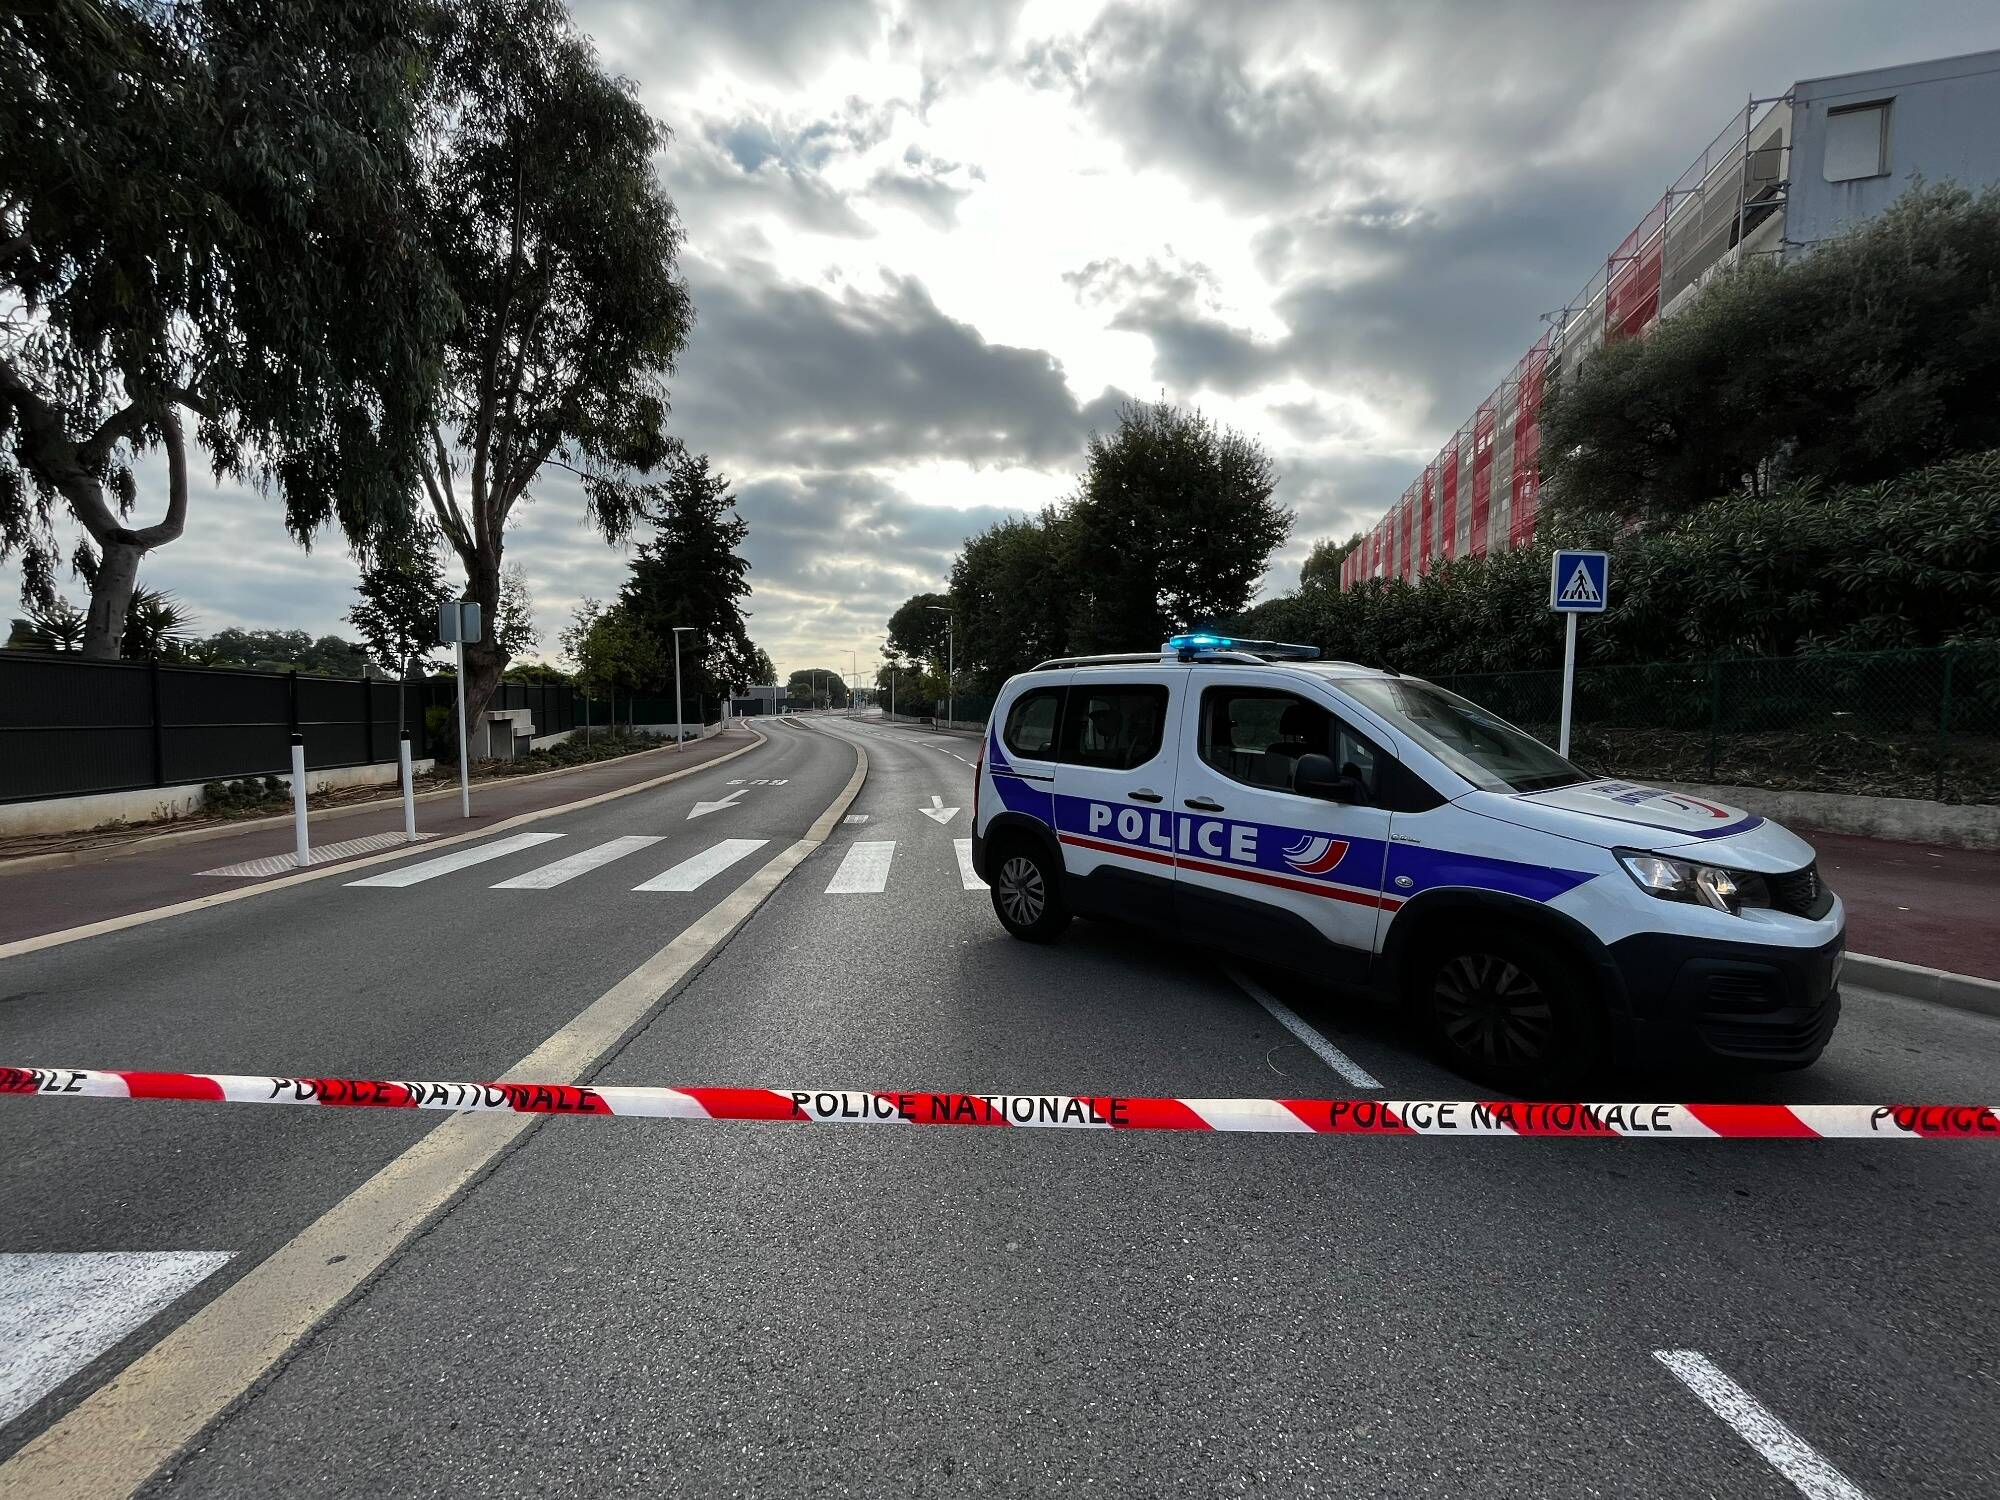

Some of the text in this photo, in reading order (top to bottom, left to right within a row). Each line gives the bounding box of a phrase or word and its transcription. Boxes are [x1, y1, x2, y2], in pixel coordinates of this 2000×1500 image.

[1089, 803, 1258, 863] POLICE
[269, 1078, 597, 1111] POLICE NATIONALE
[791, 1092, 1130, 1125] POLICE NATIONALE
[1330, 1101, 1675, 1132] POLICE NATIONALE
[1870, 1106, 1997, 1132] POLICE
